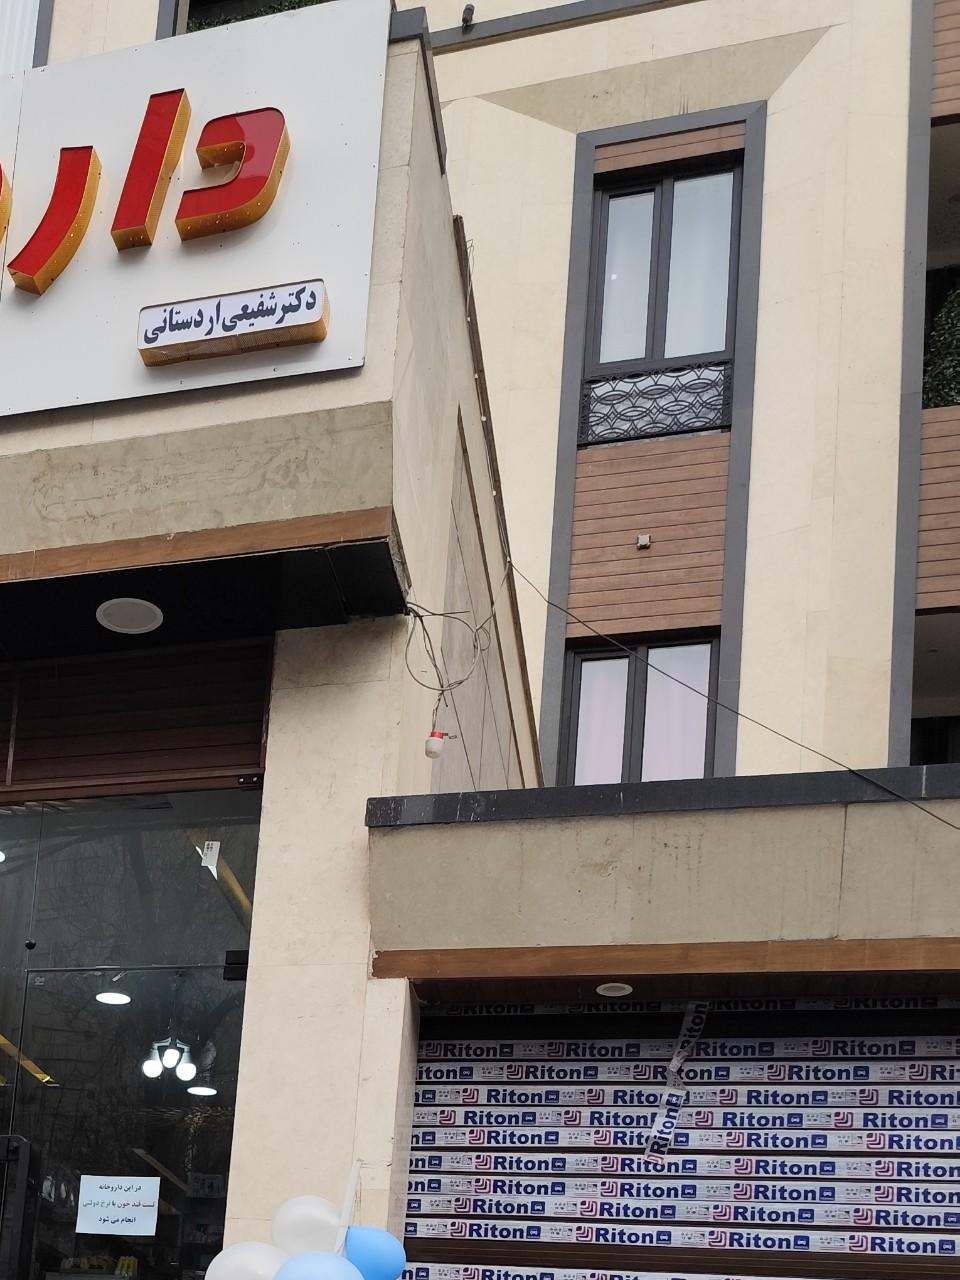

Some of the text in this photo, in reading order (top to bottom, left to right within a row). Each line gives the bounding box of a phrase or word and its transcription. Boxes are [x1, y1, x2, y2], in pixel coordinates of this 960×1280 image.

[143, 286, 317, 344] دکتر شفیعی اردستانی
[443, 1040, 898, 1057] Riton Riton Riton Riton
[525, 1064, 851, 1080] Riton Riton
[486, 1089, 954, 1106] Riton Riton Riton
[464, 1110, 928, 1128] Riton Riton Riton Riton
[487, 1131, 954, 1150] Riton Riton Riton
[493, 1156, 549, 1170] Riton
[754, 1160, 816, 1175] Riton
[492, 1180, 548, 1195] Riton
[620, 1182, 680, 1197] Riton
[754, 1184, 816, 1200] Riton
[472, 1199, 941, 1226] Riton Riton Riton Riton
[468, 1223, 936, 1254] Riton Riton Riton Riton
